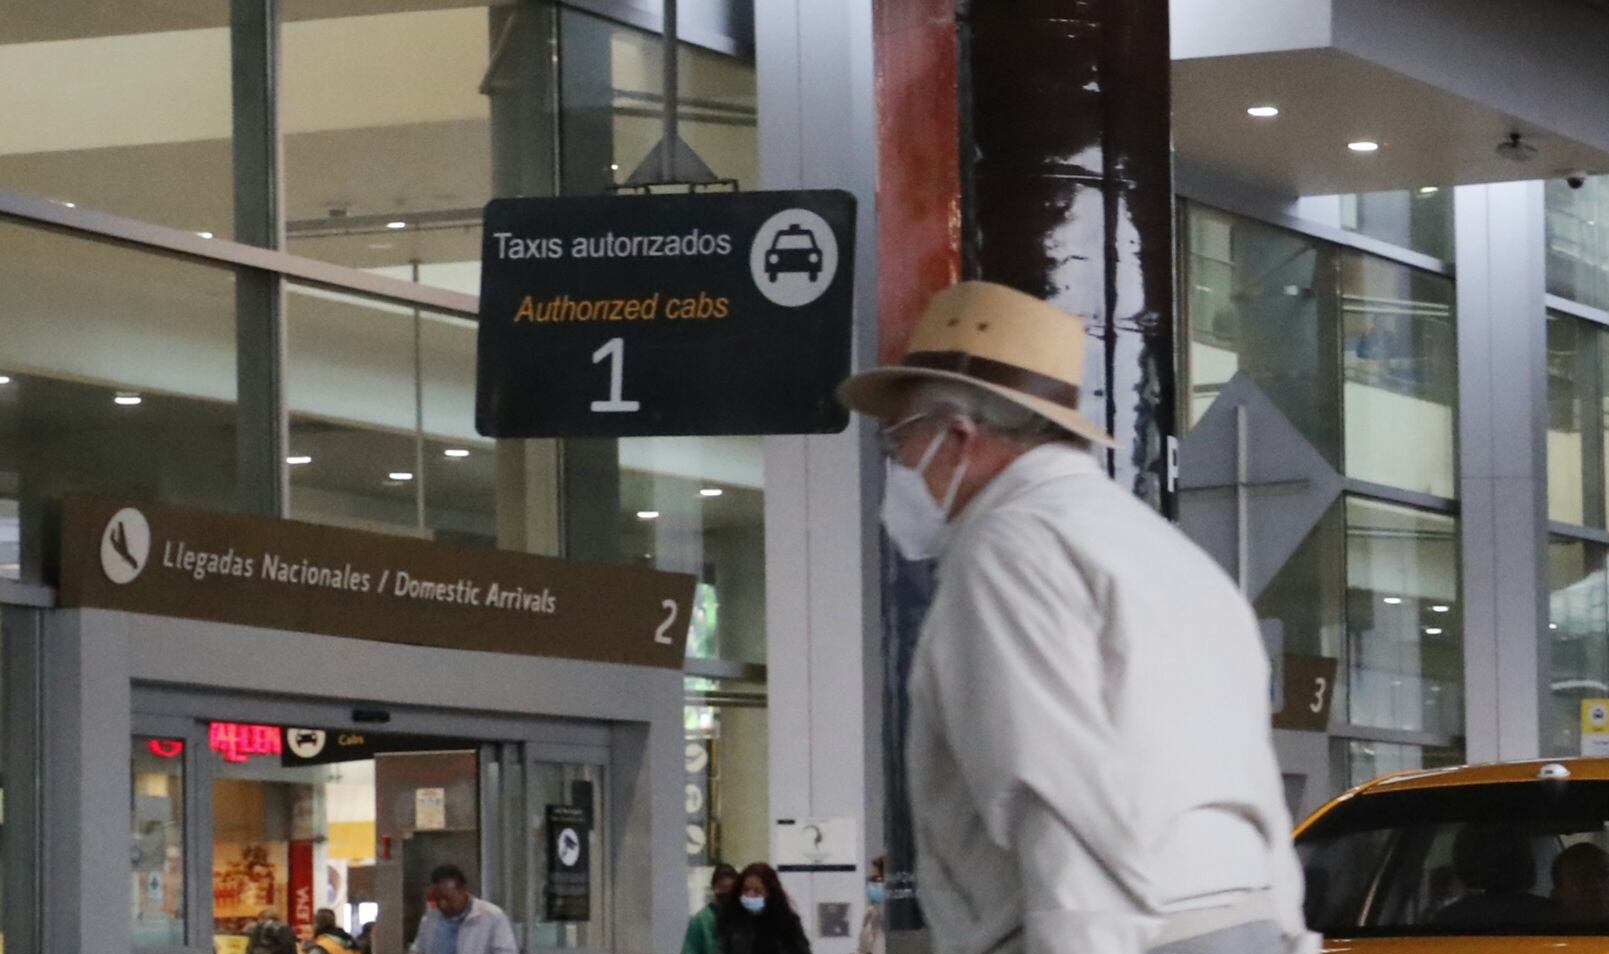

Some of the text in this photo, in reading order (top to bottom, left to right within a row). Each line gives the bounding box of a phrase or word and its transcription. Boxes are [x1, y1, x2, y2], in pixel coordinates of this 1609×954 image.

[493, 228, 732, 260] Taxis autorizados
[513, 291, 730, 323] Authorized cabs
[590, 337, 641, 412] 1
[162, 540, 254, 580] Llegadas
[260, 553, 371, 593] Nacionales
[394, 570, 481, 605] Domestic
[484, 582, 558, 614] Arrivals
[653, 598, 678, 645] 2
[1308, 677, 1327, 713] 3
